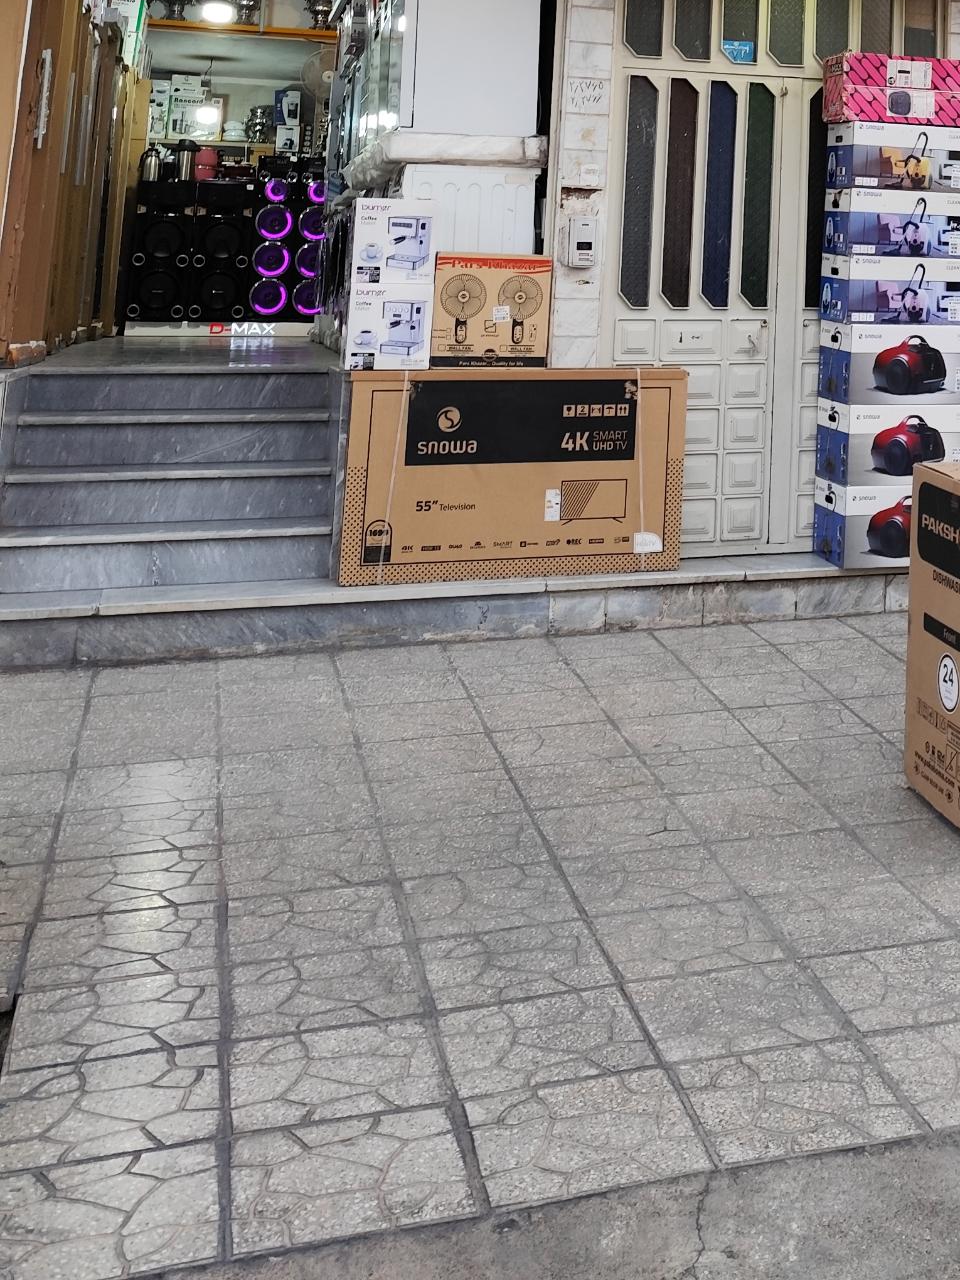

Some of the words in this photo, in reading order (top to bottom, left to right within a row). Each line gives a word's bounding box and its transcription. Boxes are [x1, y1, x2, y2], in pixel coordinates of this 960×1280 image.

[209, 322, 276, 336] D-MAX
[417, 439, 478, 455] snowa
[560, 431, 590, 452] 4K
[593, 430, 628, 441] SMART
[592, 441, 614, 451] UHD
[614, 440, 628, 451] TV
[439, 502, 476, 512] Television
[943, 627, 957, 644] Front
[942, 663, 954, 687] 24
